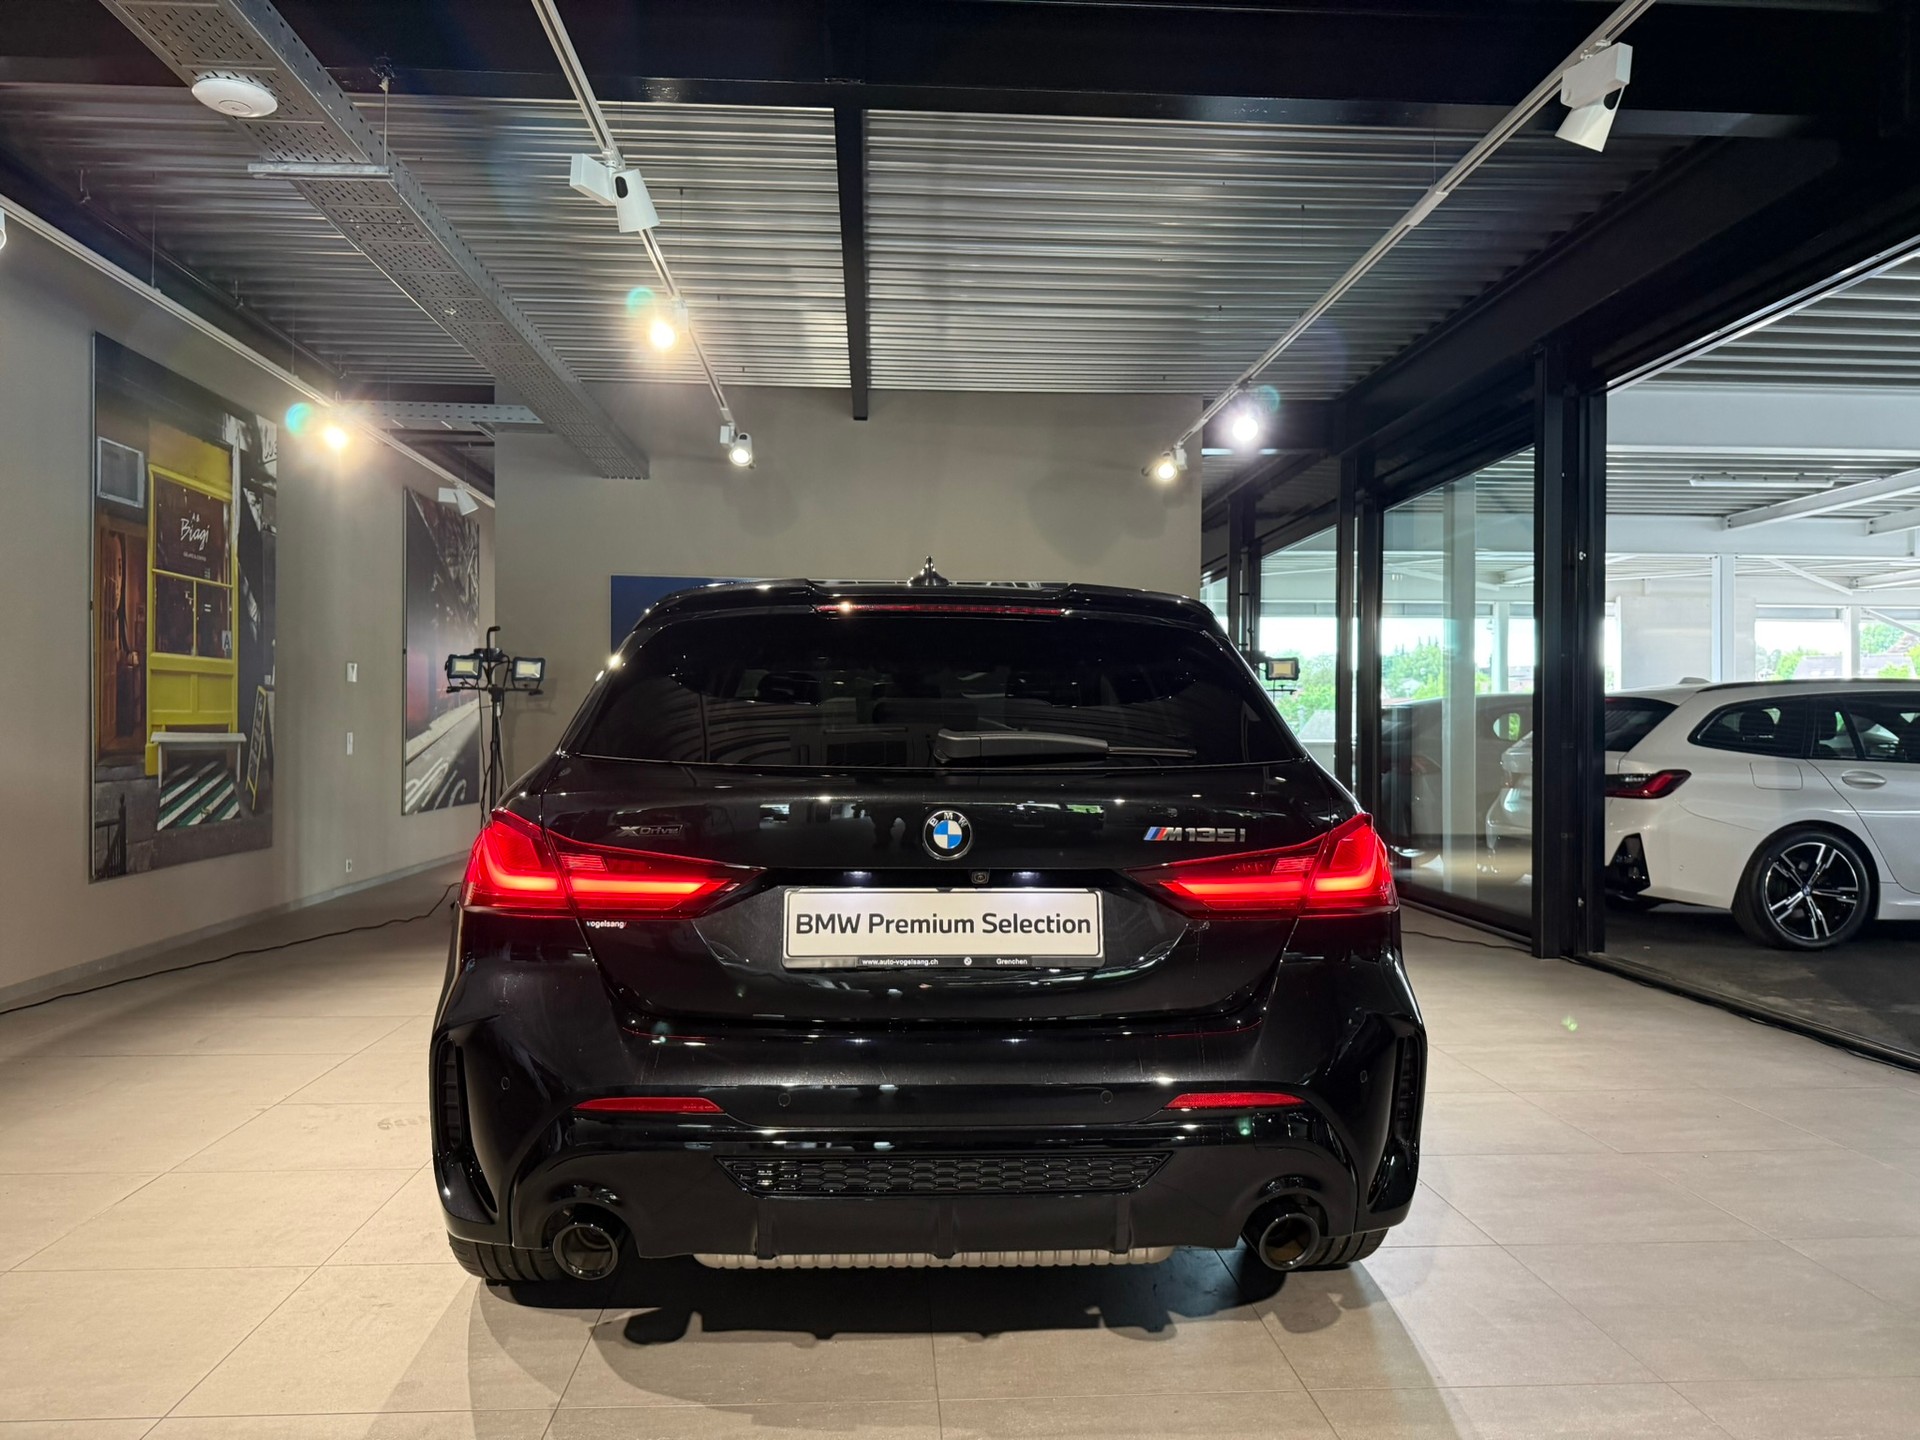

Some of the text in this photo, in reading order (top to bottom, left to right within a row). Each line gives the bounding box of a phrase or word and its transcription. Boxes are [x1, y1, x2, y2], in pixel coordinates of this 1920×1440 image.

[180, 518, 210, 551] Biagi
[223, 634, 231, 649] A
[929, 811, 968, 828] BMW
[586, 919, 626, 930] vogelsang
[796, 912, 1091, 934] BMW Premium Selection
[861, 957, 1028, 967] www.auto-vogelsang.ch Grenchen
